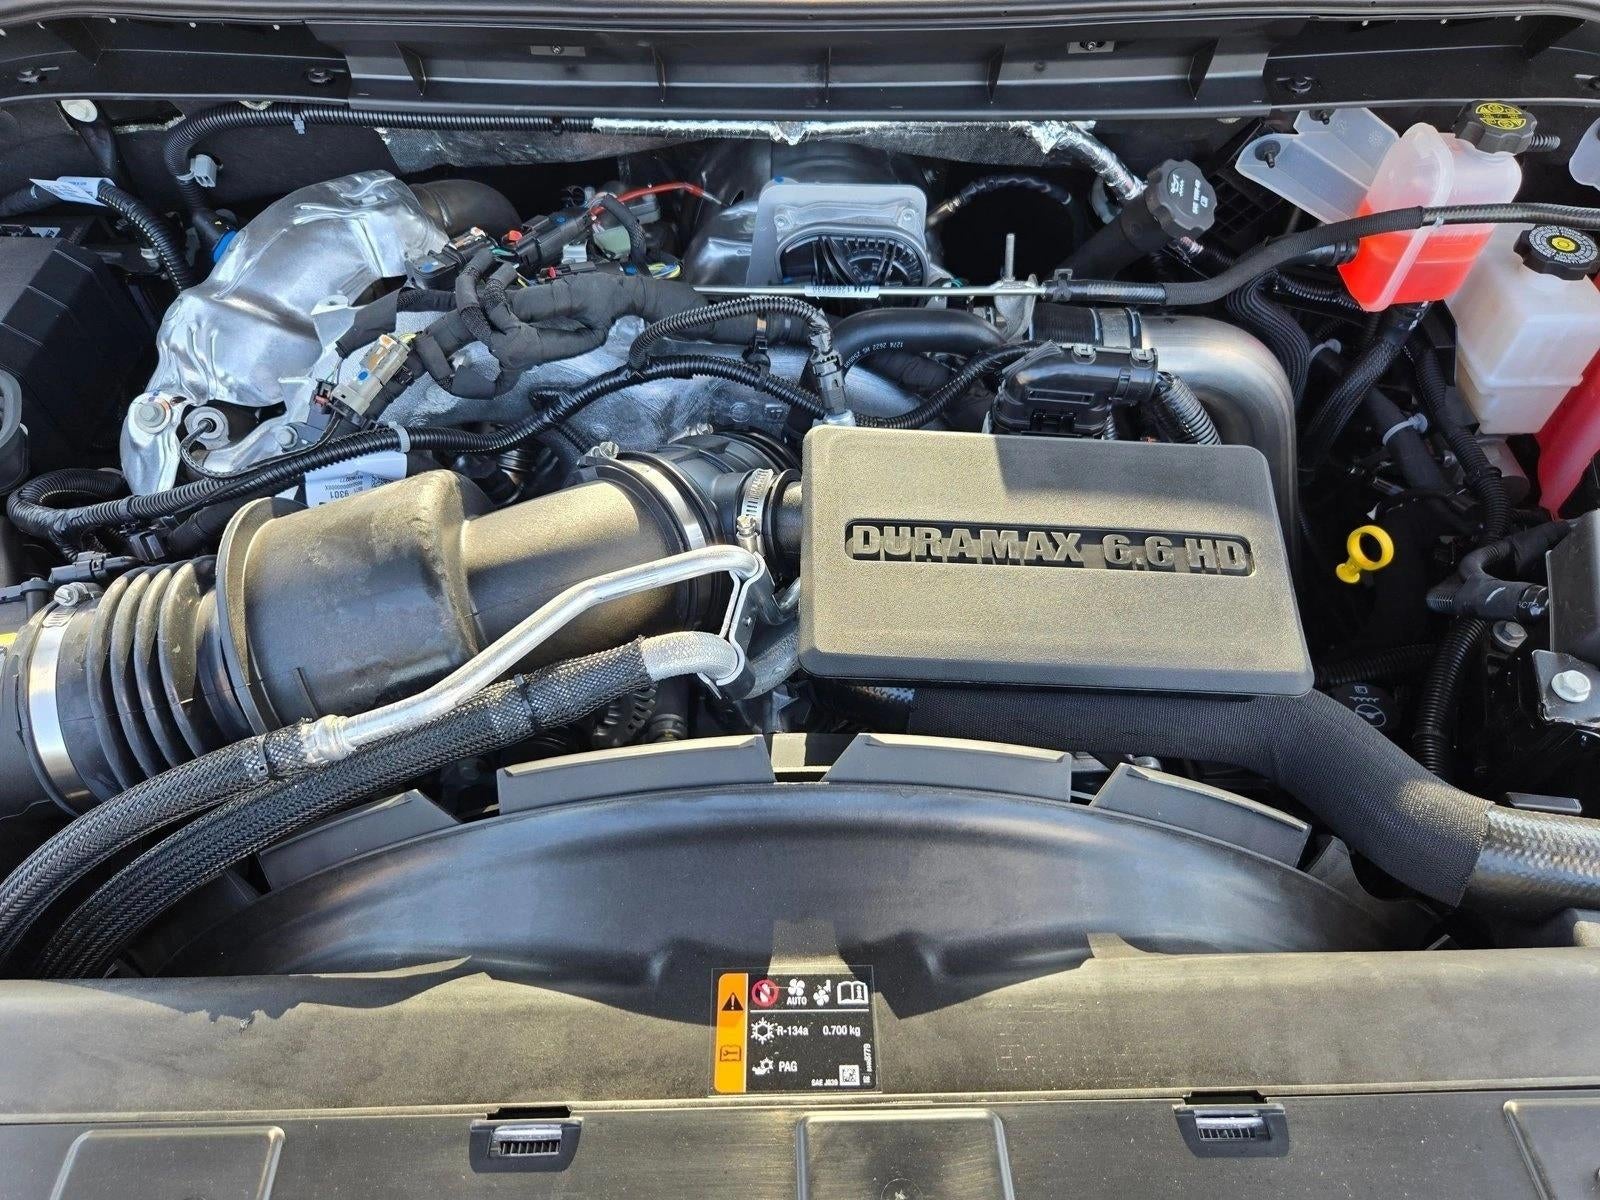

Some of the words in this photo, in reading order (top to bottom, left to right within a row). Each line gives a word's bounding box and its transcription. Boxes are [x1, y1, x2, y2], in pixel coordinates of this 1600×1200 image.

[329, 490, 350, 499] 9301
[851, 525, 1084, 564] DURAMAX
[1102, 534, 1176, 569] 6.6
[1184, 538, 1250, 574] HD
[786, 996, 807, 1006] AUTO
[776, 1025, 809, 1036] R-134a
[822, 1025, 848, 1036] 0.700
[849, 1025, 861, 1038] kg
[778, 1060, 798, 1072] PAG
